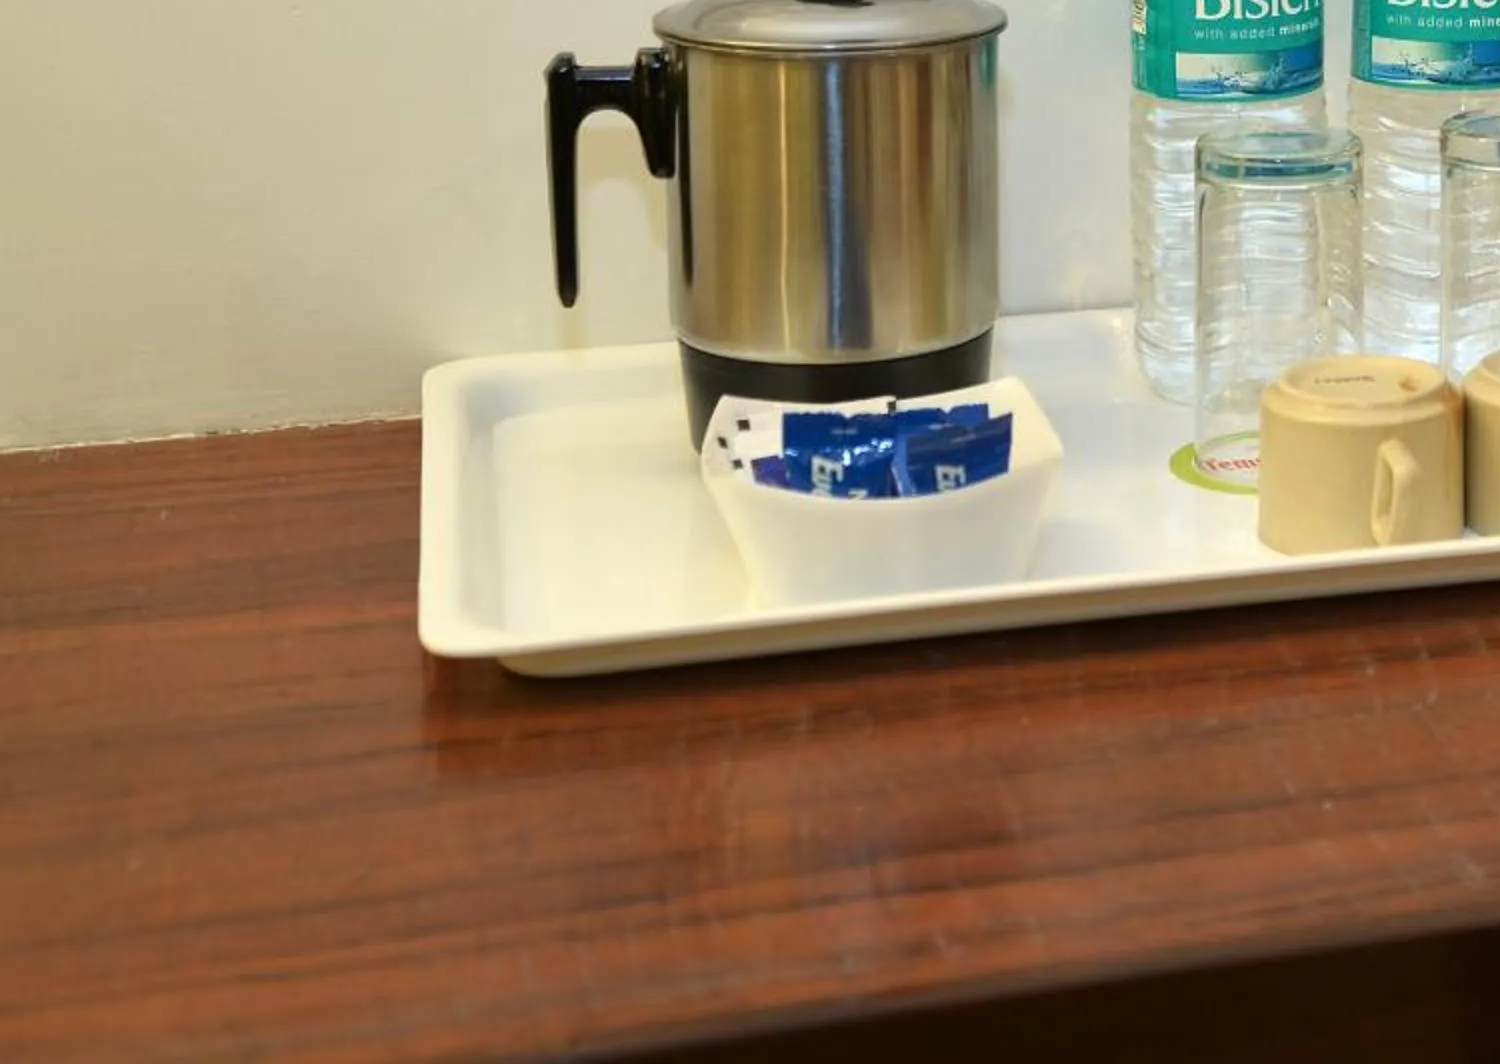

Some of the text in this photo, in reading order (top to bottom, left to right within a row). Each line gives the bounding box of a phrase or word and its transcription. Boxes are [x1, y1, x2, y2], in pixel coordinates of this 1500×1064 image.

[1386, 14, 1411, 25] with
[1418, 14, 1463, 28] added
[1194, 26, 1223, 39] with
[1230, 27, 1275, 39] added
